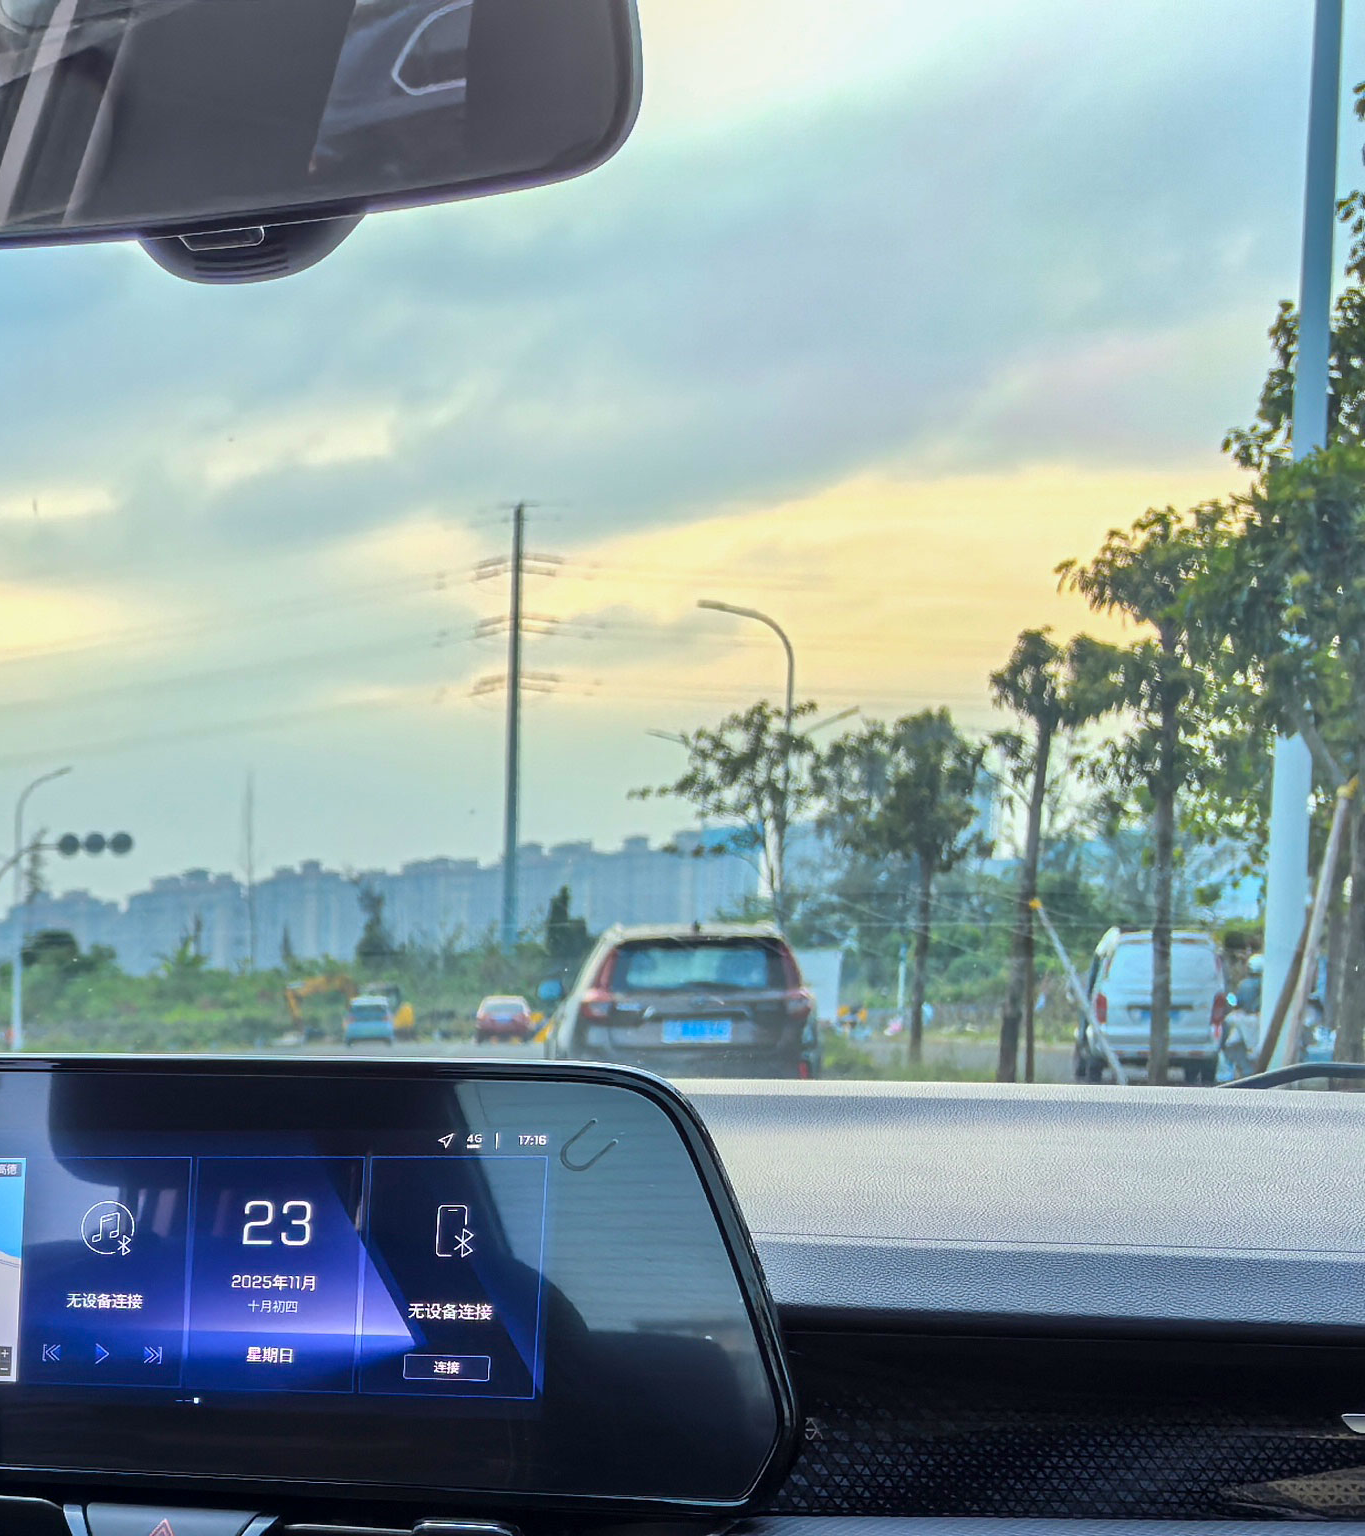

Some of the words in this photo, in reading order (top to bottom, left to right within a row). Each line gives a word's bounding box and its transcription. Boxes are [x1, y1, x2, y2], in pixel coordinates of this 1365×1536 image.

[466, 1133, 483, 1144] 4G
[518, 1135, 547, 1146] 17:16
[241, 1200, 313, 1246] 23
[231, 1274, 316, 1291] 2025年11月
[66, 1293, 143, 1309] 无设备连接
[247, 1299, 299, 1313] 十月初四
[408, 1303, 493, 1320] 无设备连接
[246, 1346, 294, 1364] 星期日
[433, 1361, 460, 1374] 连接
